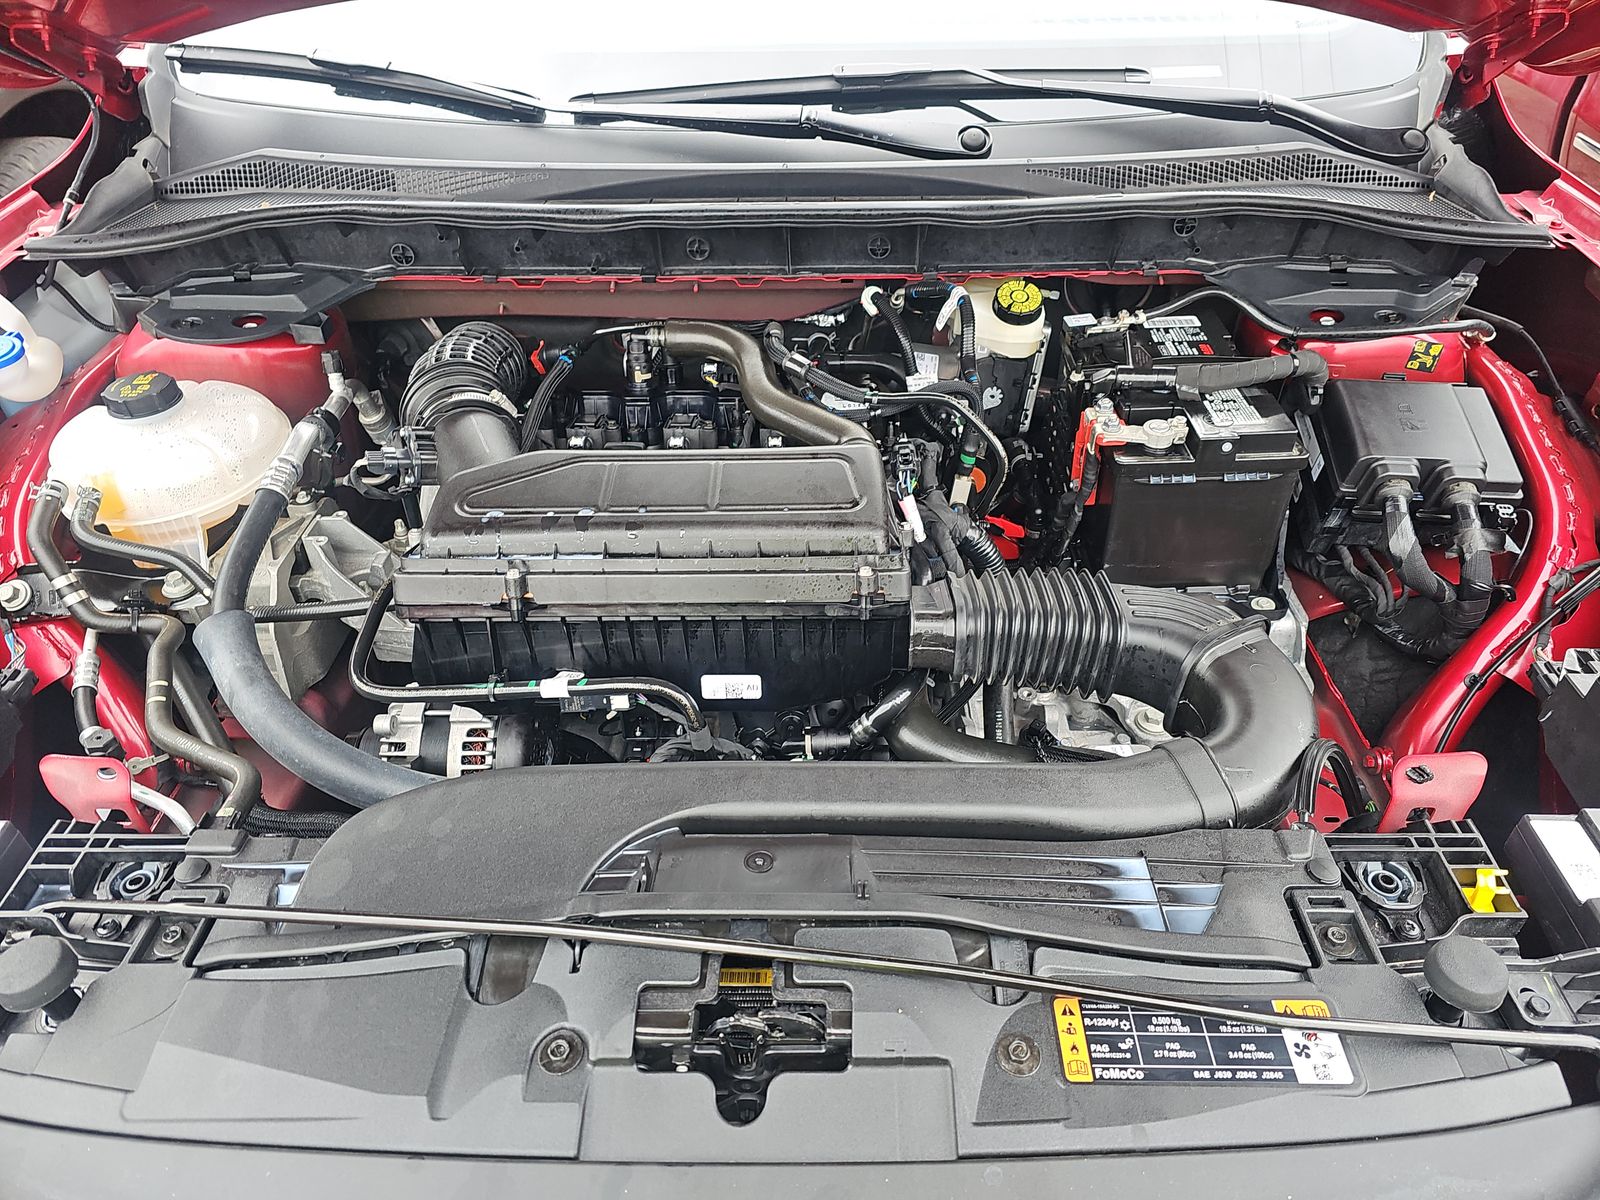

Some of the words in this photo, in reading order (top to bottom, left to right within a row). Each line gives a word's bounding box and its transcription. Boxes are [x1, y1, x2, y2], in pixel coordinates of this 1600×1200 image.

[1084, 1017, 1119, 1028] R-1234yf
[1151, 1016, 1171, 1025] 0.500
[1171, 1017, 1182, 1027] kg
[1090, 1044, 1110, 1052] PAG
[1165, 1042, 1181, 1050] PAG
[1240, 1043, 1257, 1051] PAG
[1095, 1068, 1145, 1080] FoMoCo
[1193, 1070, 1211, 1079] SAE
